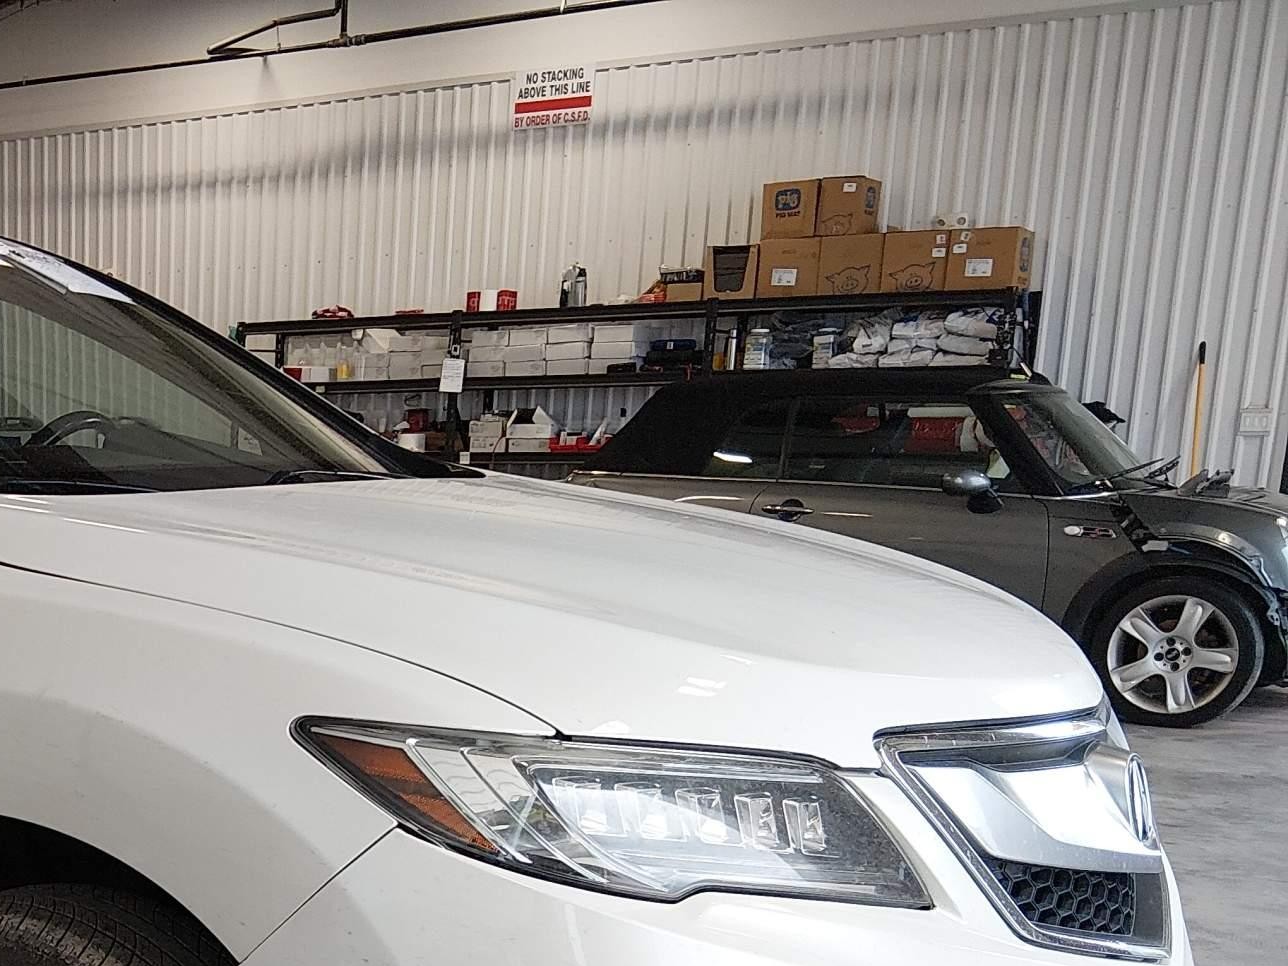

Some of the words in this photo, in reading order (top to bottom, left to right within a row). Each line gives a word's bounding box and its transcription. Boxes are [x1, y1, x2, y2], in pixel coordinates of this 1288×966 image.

[526, 72, 538, 85] NO
[540, 67, 584, 82] STACKING
[517, 86, 547, 99] ABOVE
[549, 83, 569, 96] THIS
[571, 81, 591, 94] LINE
[514, 117, 524, 128] BY
[525, 114, 550, 127] ORDER
[552, 112, 562, 124] OF
